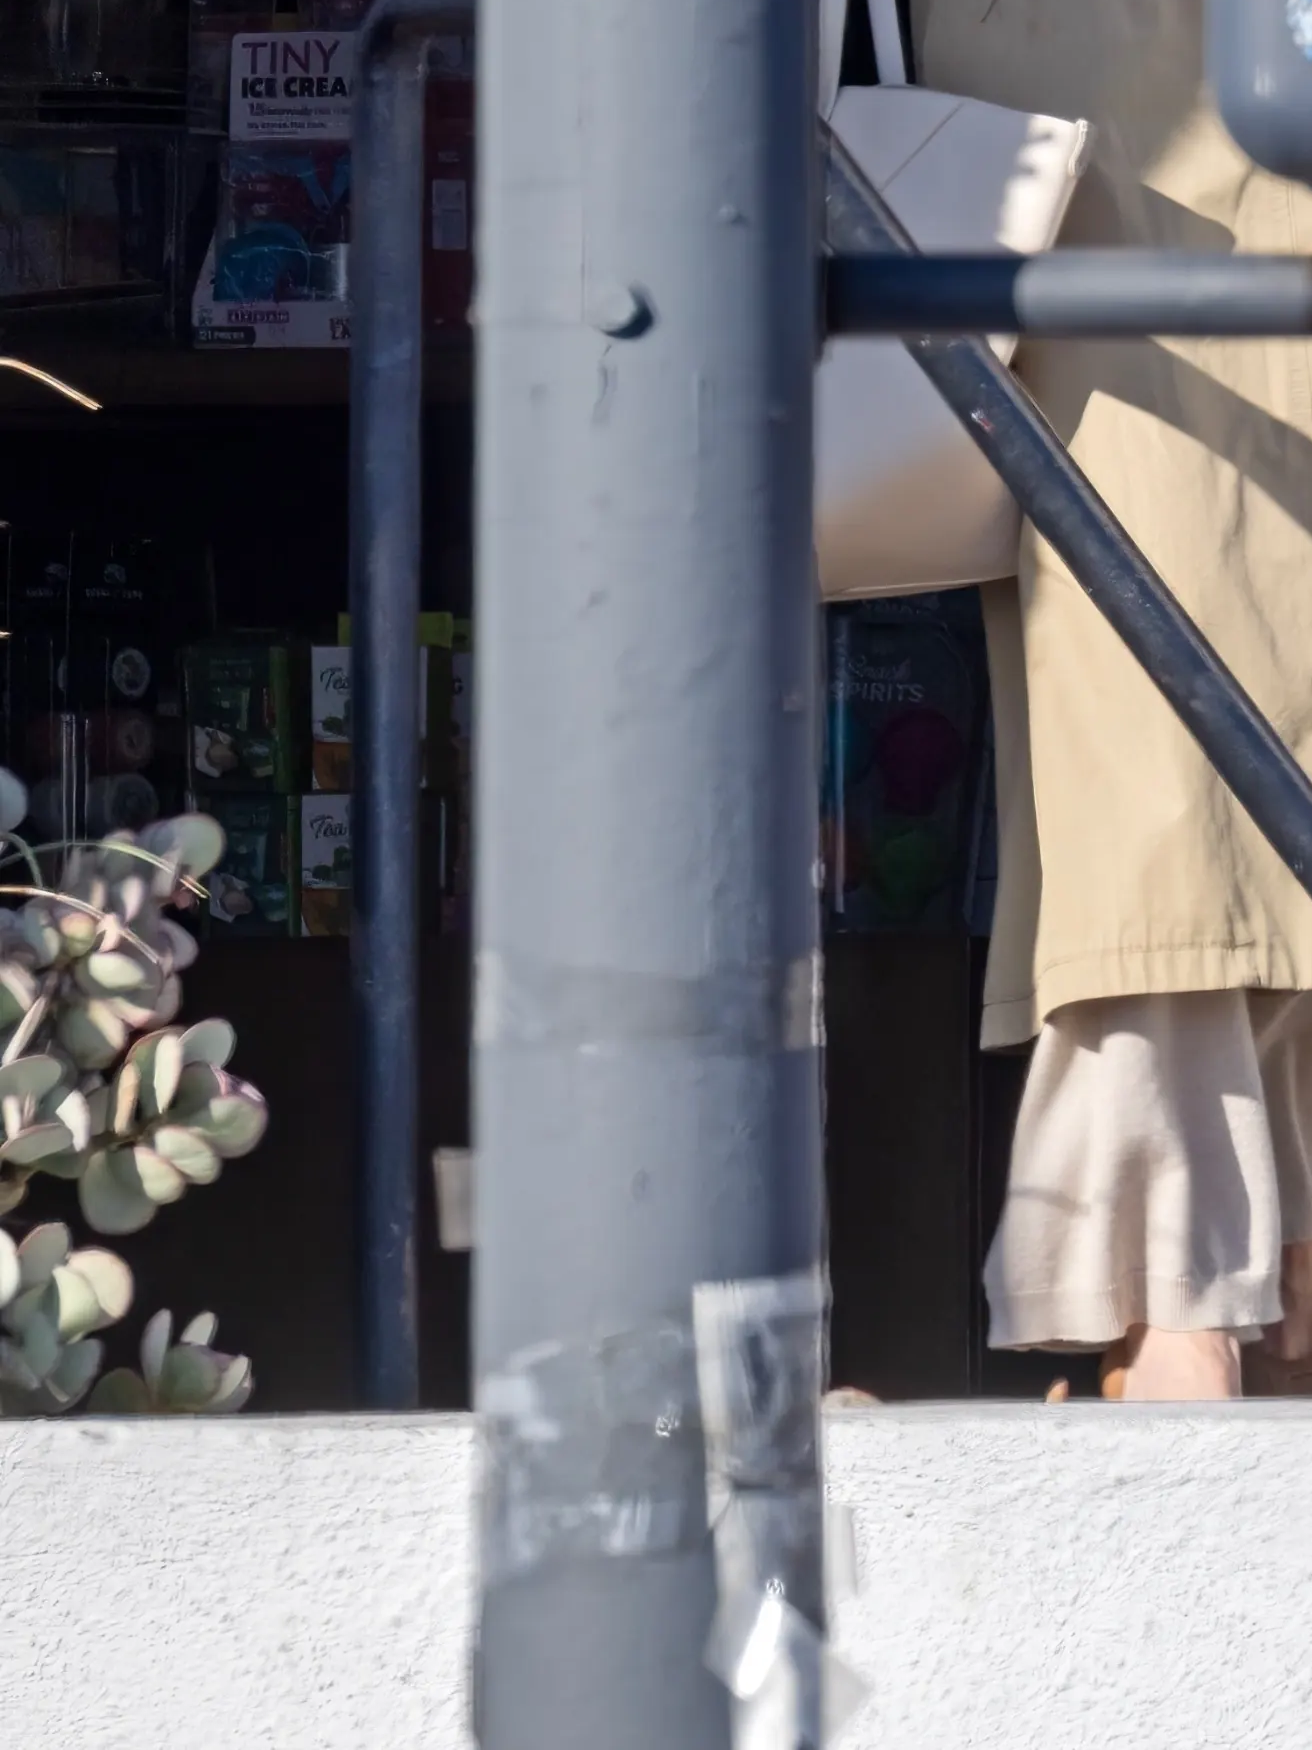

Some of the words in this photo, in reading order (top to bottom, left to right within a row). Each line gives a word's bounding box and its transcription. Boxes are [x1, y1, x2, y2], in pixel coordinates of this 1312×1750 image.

[242, 39, 341, 74] TINY
[241, 77, 277, 98] ICE
[283, 76, 354, 98] CREA
